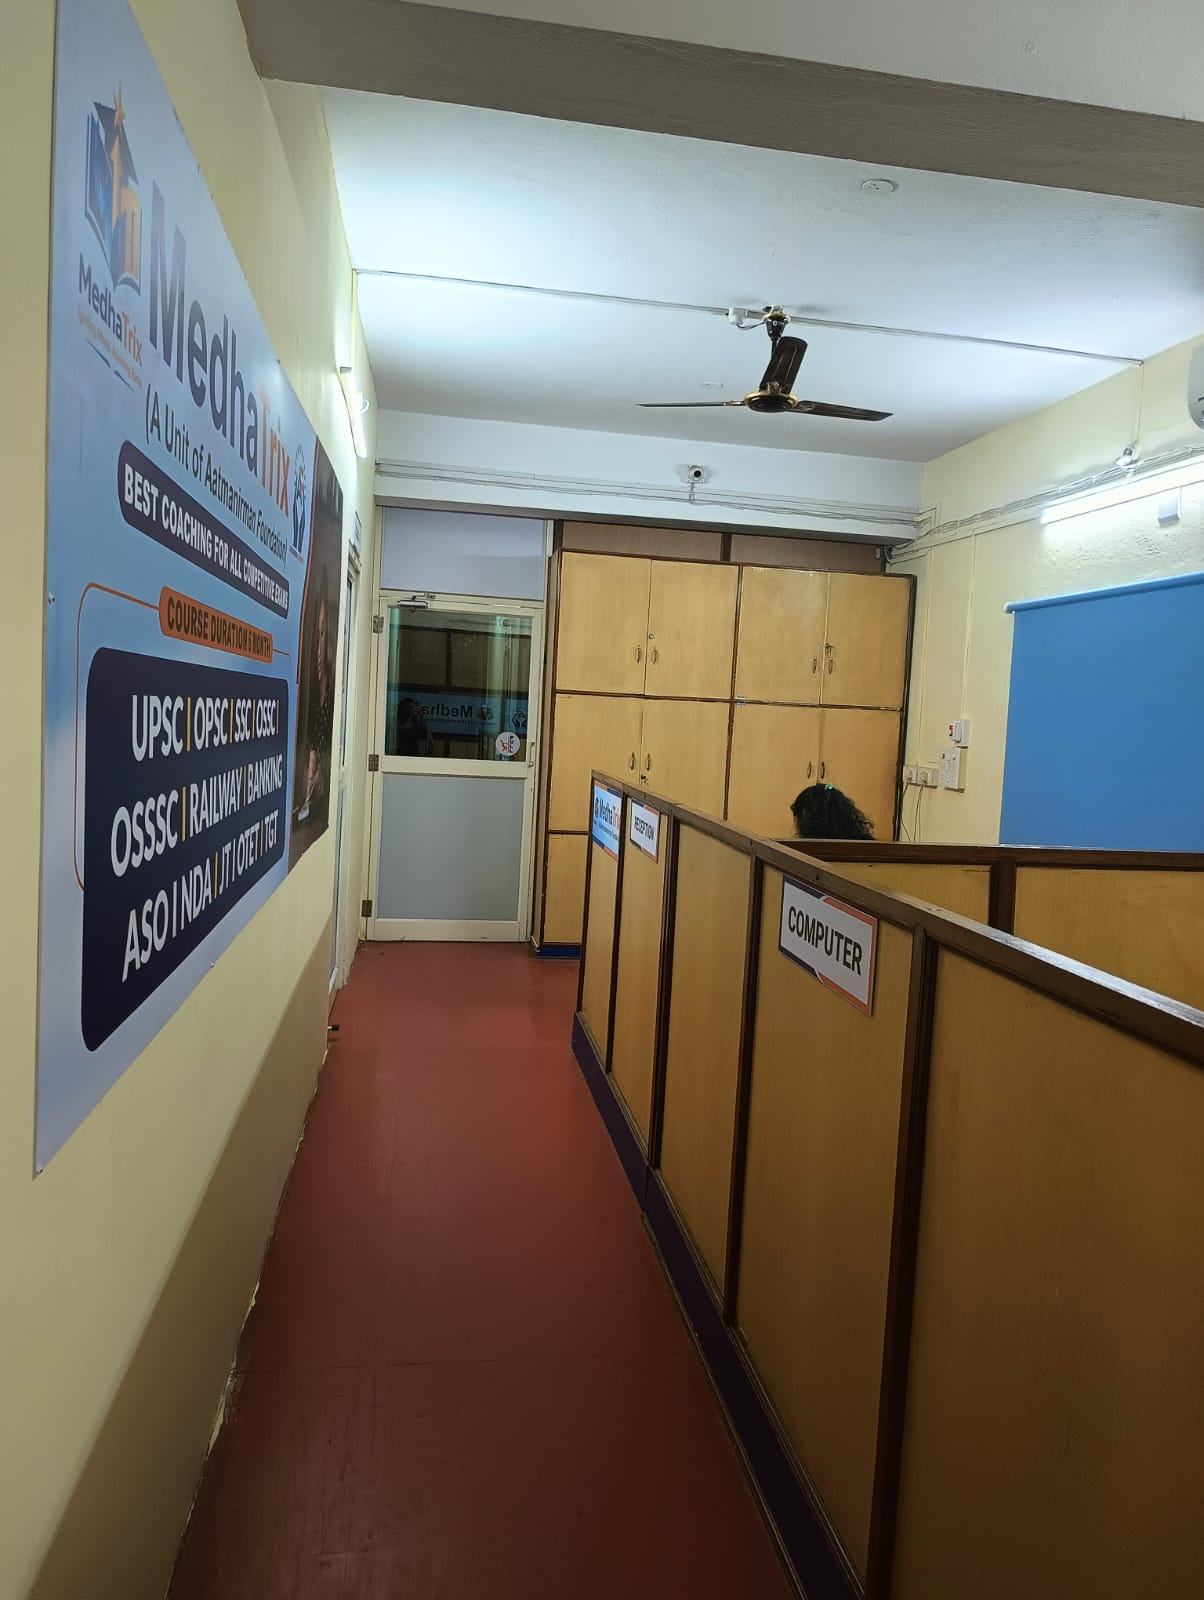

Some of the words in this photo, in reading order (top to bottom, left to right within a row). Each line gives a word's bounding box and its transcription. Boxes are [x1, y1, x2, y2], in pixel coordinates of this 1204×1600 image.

[79, 252, 142, 368] MedhaTrix
[150, 180, 290, 518] MedhaTrix
[146, 383, 161, 444] (A
[165, 403, 189, 471] Unit
[192, 444, 204, 482] of
[204, 452, 256, 535] Aatmanirman
[124, 462, 159, 522] BEST
[161, 494, 213, 559] COACHING
[214, 535, 229, 570] FOR
[229, 548, 242, 579] ALL
[243, 558, 275, 601] COMPETITIVE
[167, 596, 209, 640] COURSE
[210, 614, 248, 652] DURATION
[252, 631, 271, 657] MONTH
[131, 694, 184, 762] UPSC
[193, 697, 228, 750] OPSC
[234, 699, 252, 743] SSC
[255, 699, 276, 738] OSSC
[110, 789, 179, 877] OSSSC
[189, 766, 243, 838] RAILWAY
[247, 754, 283, 805] BANKING
[634, 815, 655, 841] RECEPTION
[122, 889, 169, 983] ASO
[180, 858, 212, 930] NDA
[218, 842, 232, 895] JT
[236, 822, 260, 876] OTET
[264, 809, 279, 852] TGT
[788, 906, 863, 976] COMPUTER
